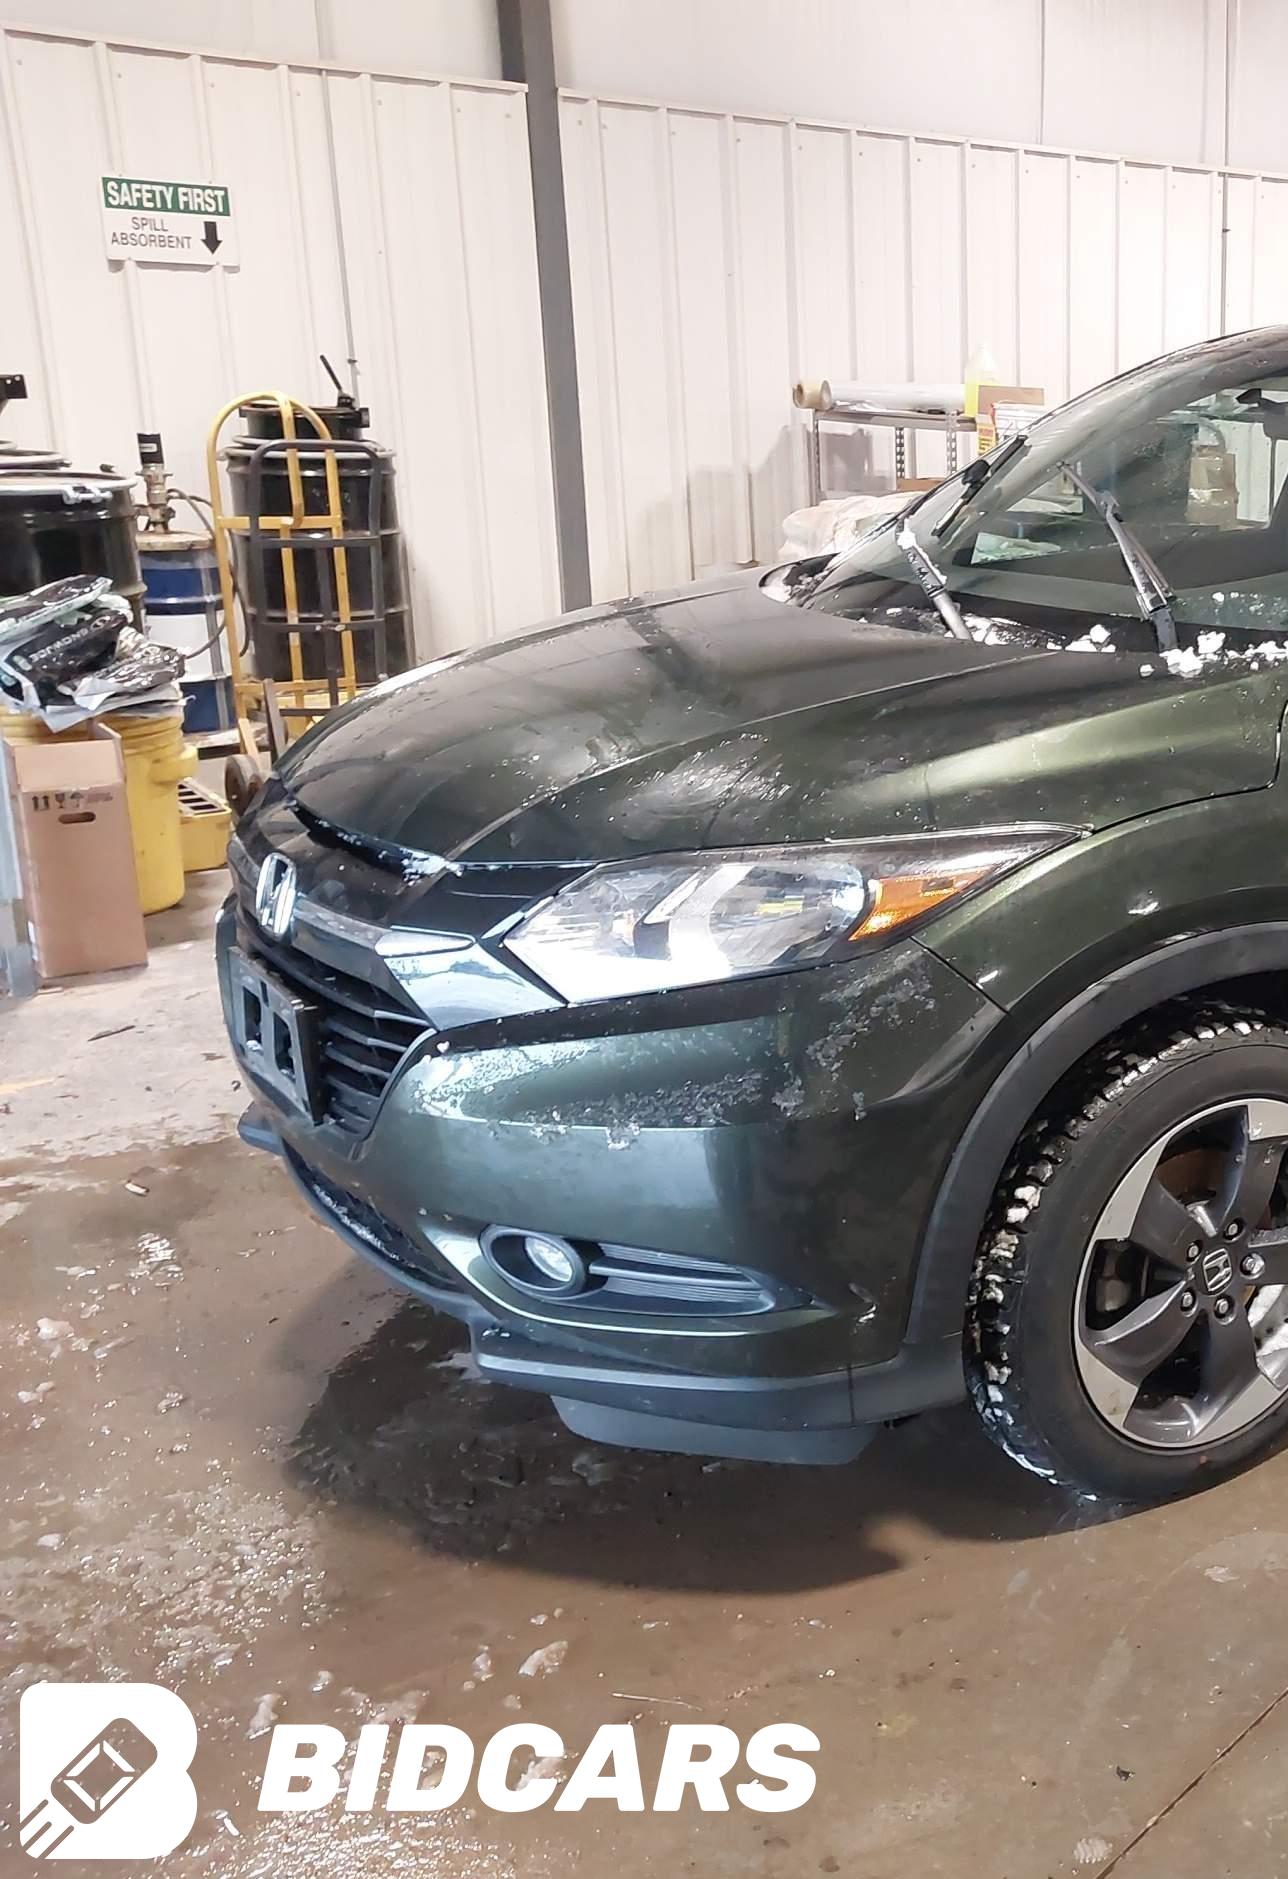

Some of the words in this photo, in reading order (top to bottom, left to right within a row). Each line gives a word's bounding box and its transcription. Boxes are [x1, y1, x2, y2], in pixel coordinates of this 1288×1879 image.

[107, 181, 174, 209] SAFETY
[178, 187, 225, 213] FIRST
[131, 216, 169, 232] SPILL
[111, 232, 192, 249] ABSORBENT
